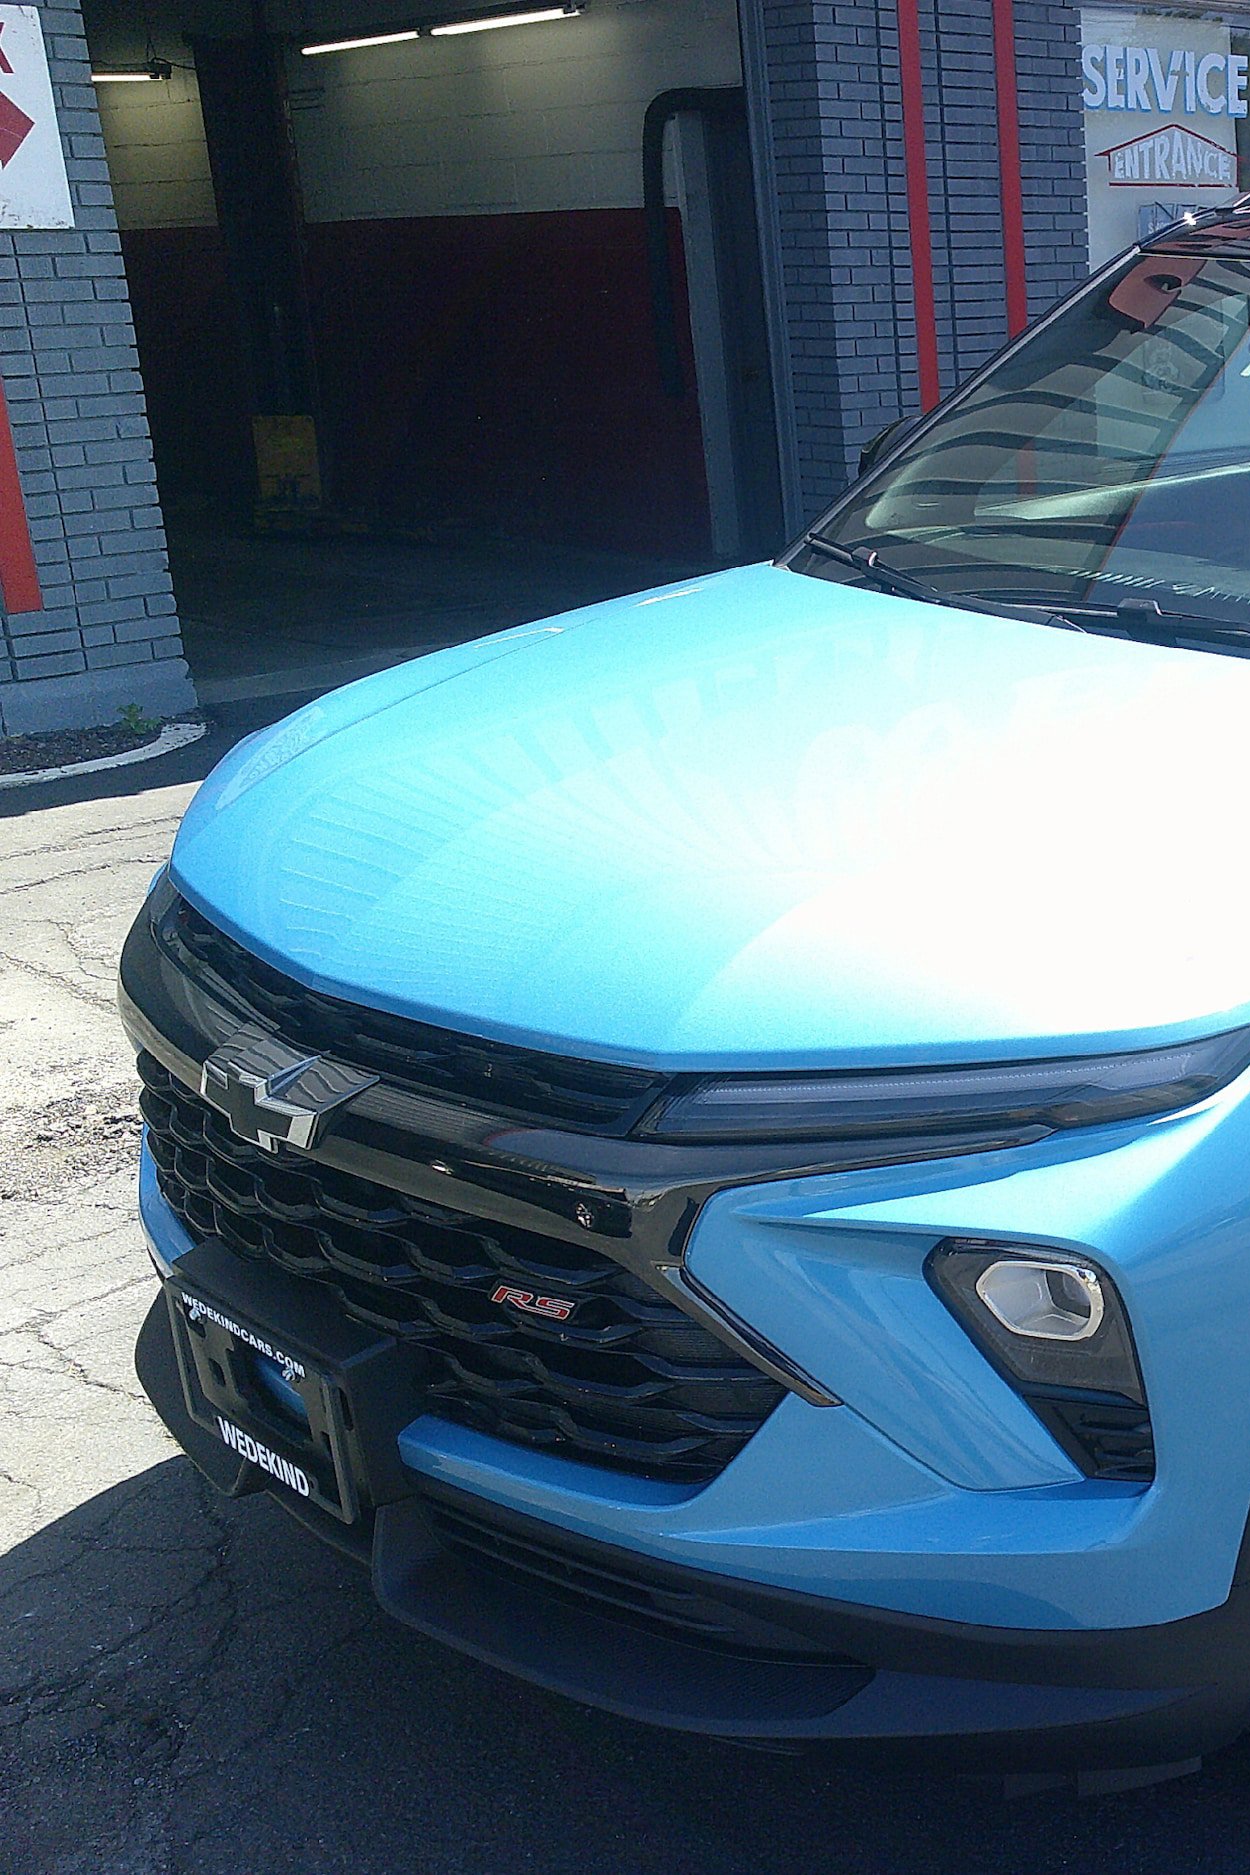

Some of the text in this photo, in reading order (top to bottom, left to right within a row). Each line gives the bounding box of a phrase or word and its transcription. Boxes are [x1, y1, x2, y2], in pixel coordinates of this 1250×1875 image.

[1082, 44, 1249, 118] SERVICE
[1113, 130, 1232, 182] ENTRANCE
[181, 1291, 306, 1379] WEDEKINDCARS.COM
[491, 1285, 575, 1321] RS
[216, 1416, 311, 1498] WEDEKIND
